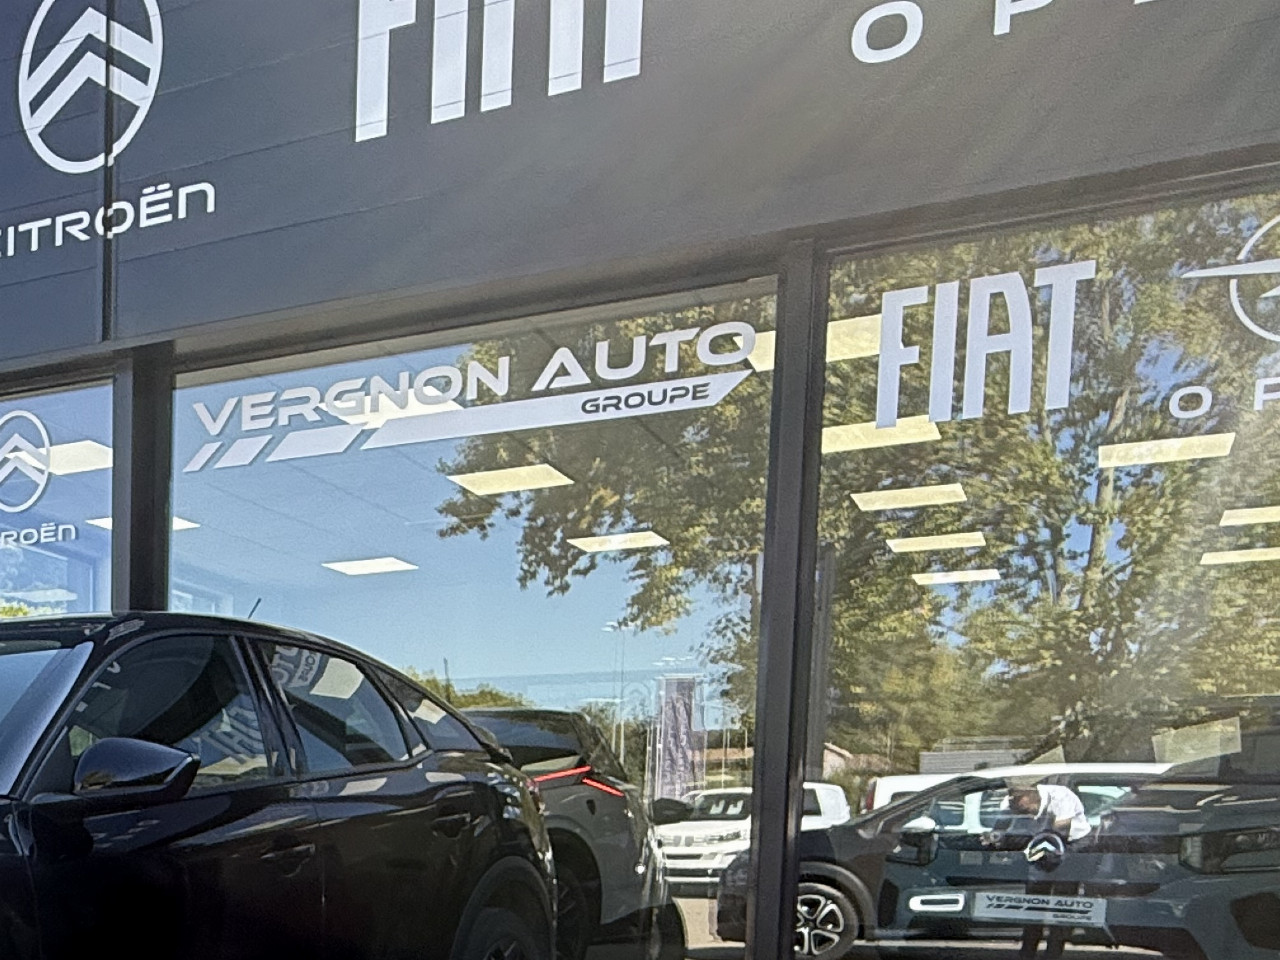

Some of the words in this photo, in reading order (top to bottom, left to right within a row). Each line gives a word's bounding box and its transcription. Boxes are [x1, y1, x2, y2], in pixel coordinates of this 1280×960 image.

[192, 356, 511, 437] VERGNON
[531, 321, 756, 391] AUTO
[876, 260, 1096, 429] FIAT
[581, 382, 711, 415] GROUPE
[985, 894, 1051, 906] VERGNON
[1054, 900, 1094, 909] AUTO
